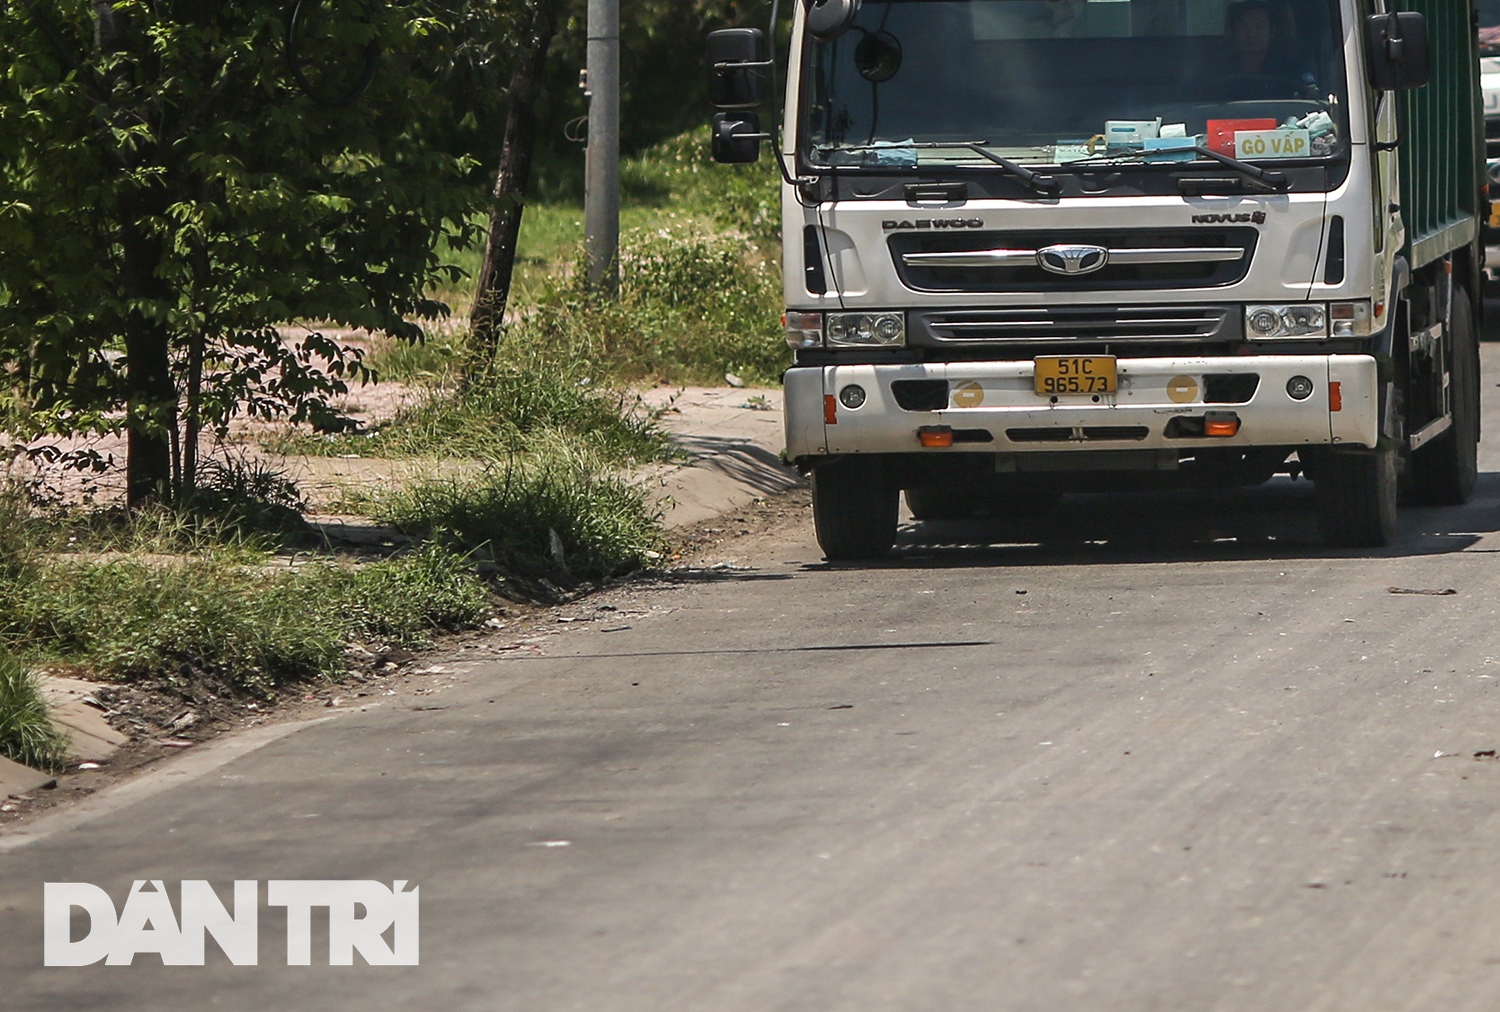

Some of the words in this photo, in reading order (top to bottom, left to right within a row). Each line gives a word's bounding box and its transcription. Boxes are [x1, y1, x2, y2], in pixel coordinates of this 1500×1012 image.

[1242, 135, 1266, 155] GÒ
[1270, 131, 1305, 154] VẤP
[882, 218, 984, 229] DAEWOO
[1192, 213, 1250, 223] NOVUS
[1058, 359, 1093, 375] 51C
[1044, 376, 1108, 393] 965.73
